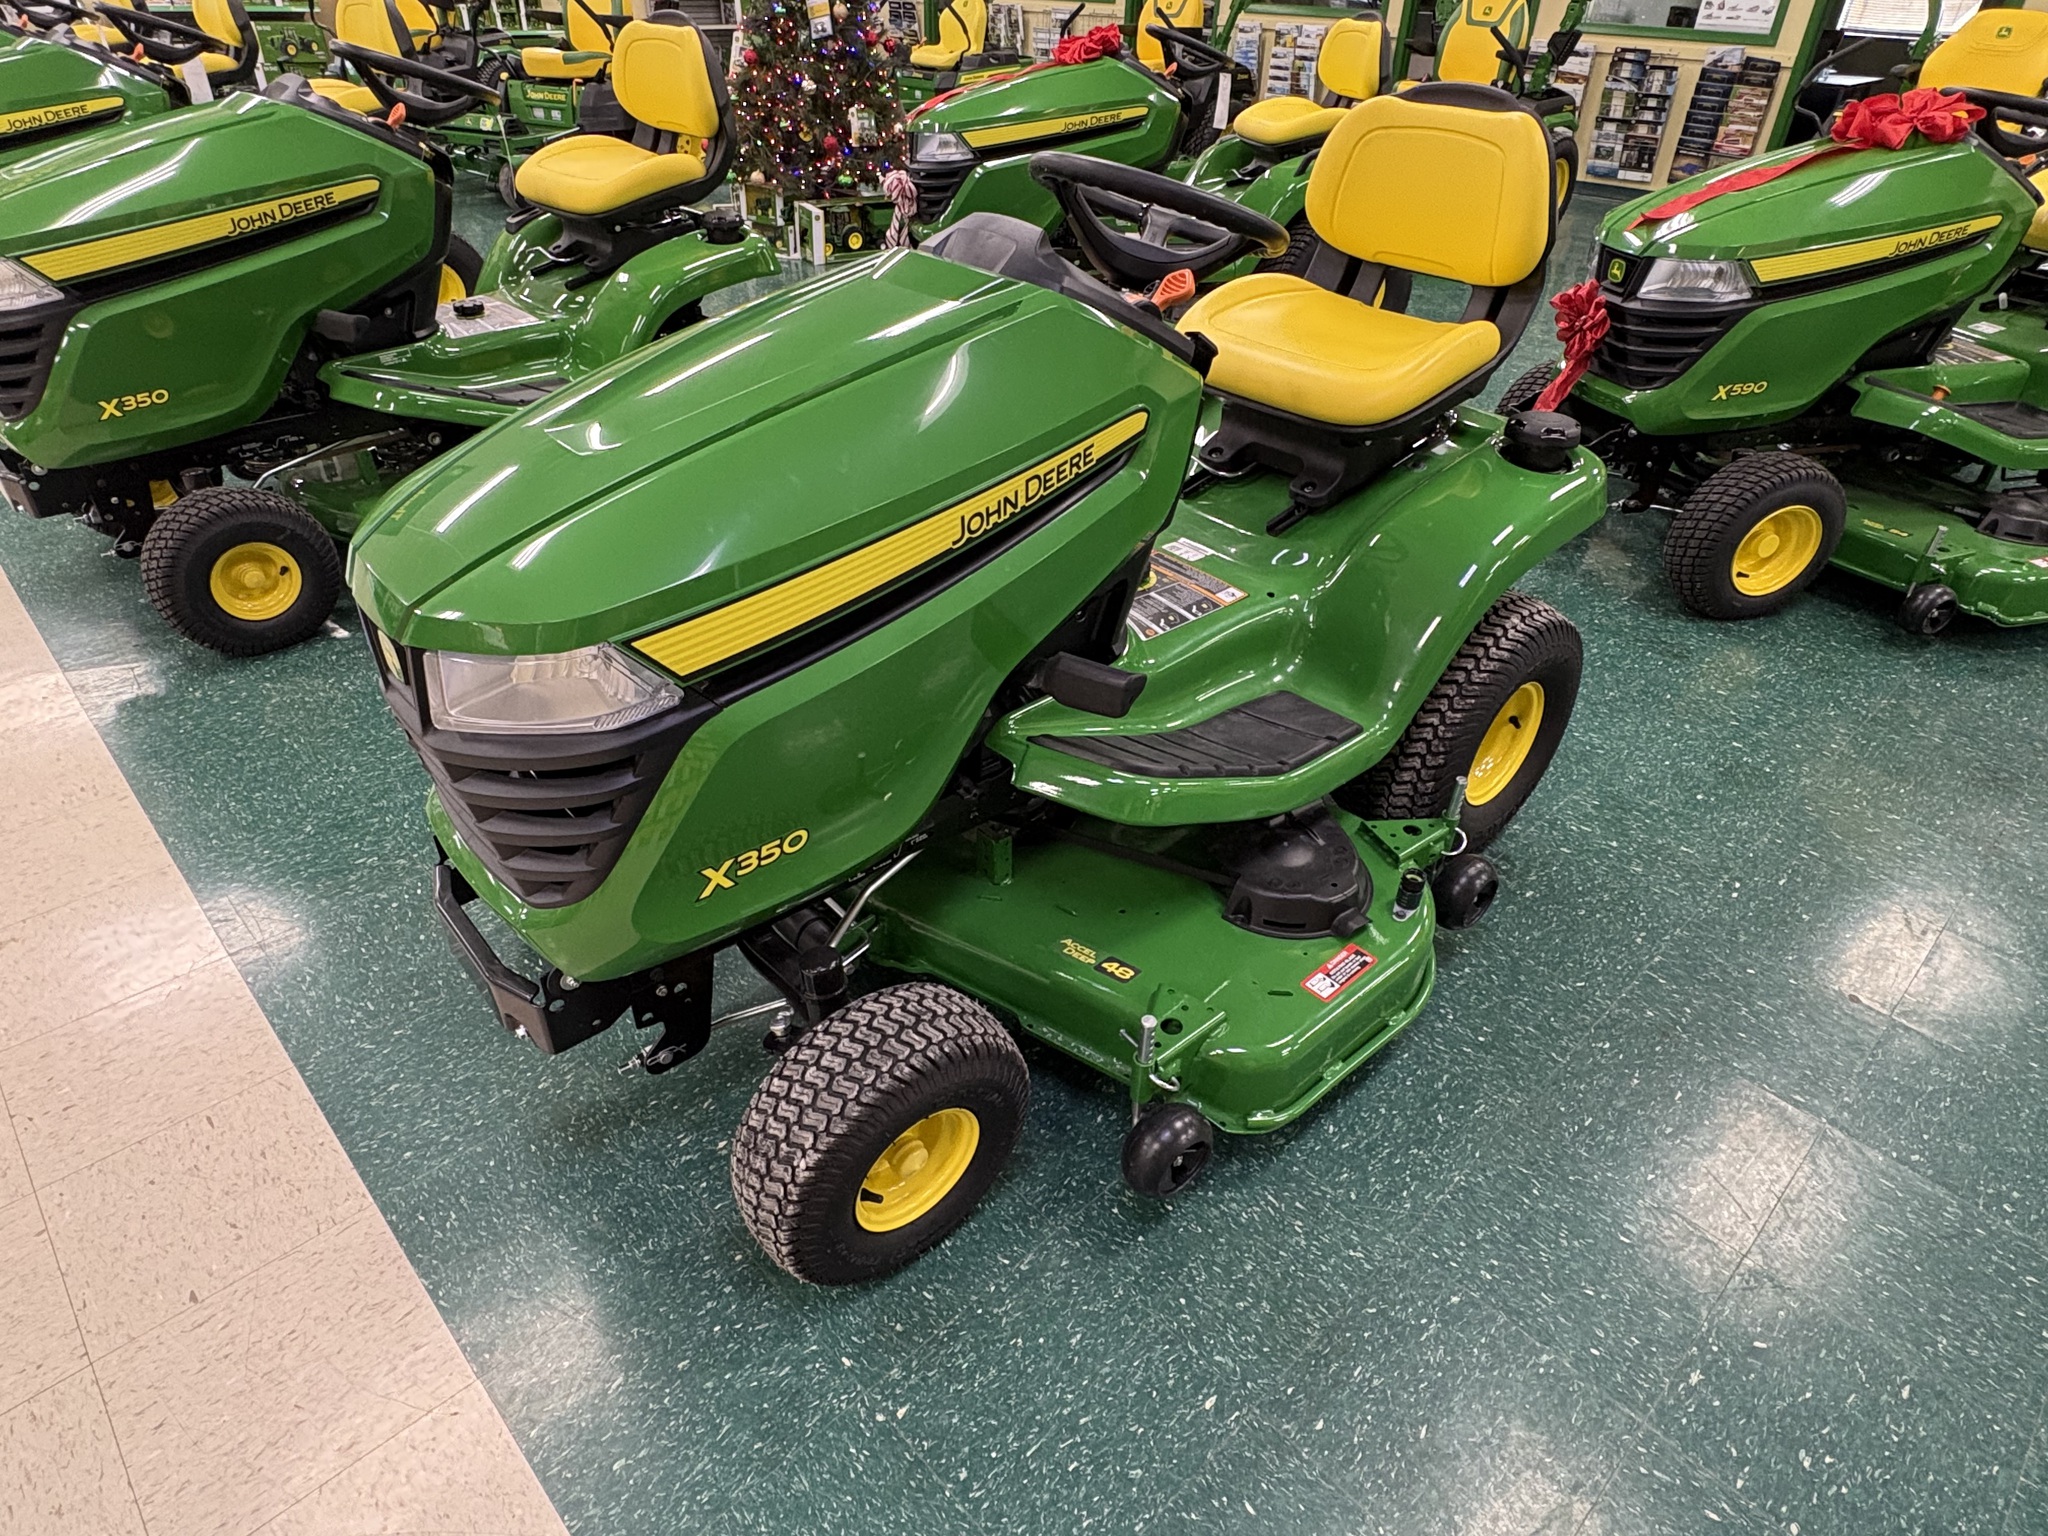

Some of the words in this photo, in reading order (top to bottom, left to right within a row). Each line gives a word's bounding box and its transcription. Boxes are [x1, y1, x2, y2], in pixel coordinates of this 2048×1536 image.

[6, 115, 42, 132] JOHN
[44, 104, 90, 122] DEERE
[1061, 119, 1088, 132] JOHN
[1090, 112, 1122, 126] DEERE
[228, 209, 276, 235] JOHN
[278, 192, 336, 219] DEERE
[1889, 236, 1928, 256] JOHN
[1928, 224, 1971, 245] DEERE
[97, 388, 170, 421] X350
[1710, 381, 1768, 402] X590
[952, 490, 1019, 546] JOHN
[1025, 443, 1095, 504] DEERE
[697, 828, 809, 901] X350
[1060, 938, 1097, 959] ACCEL
[1062, 946, 1097, 965] DEEP
[1101, 962, 1135, 980] 48
